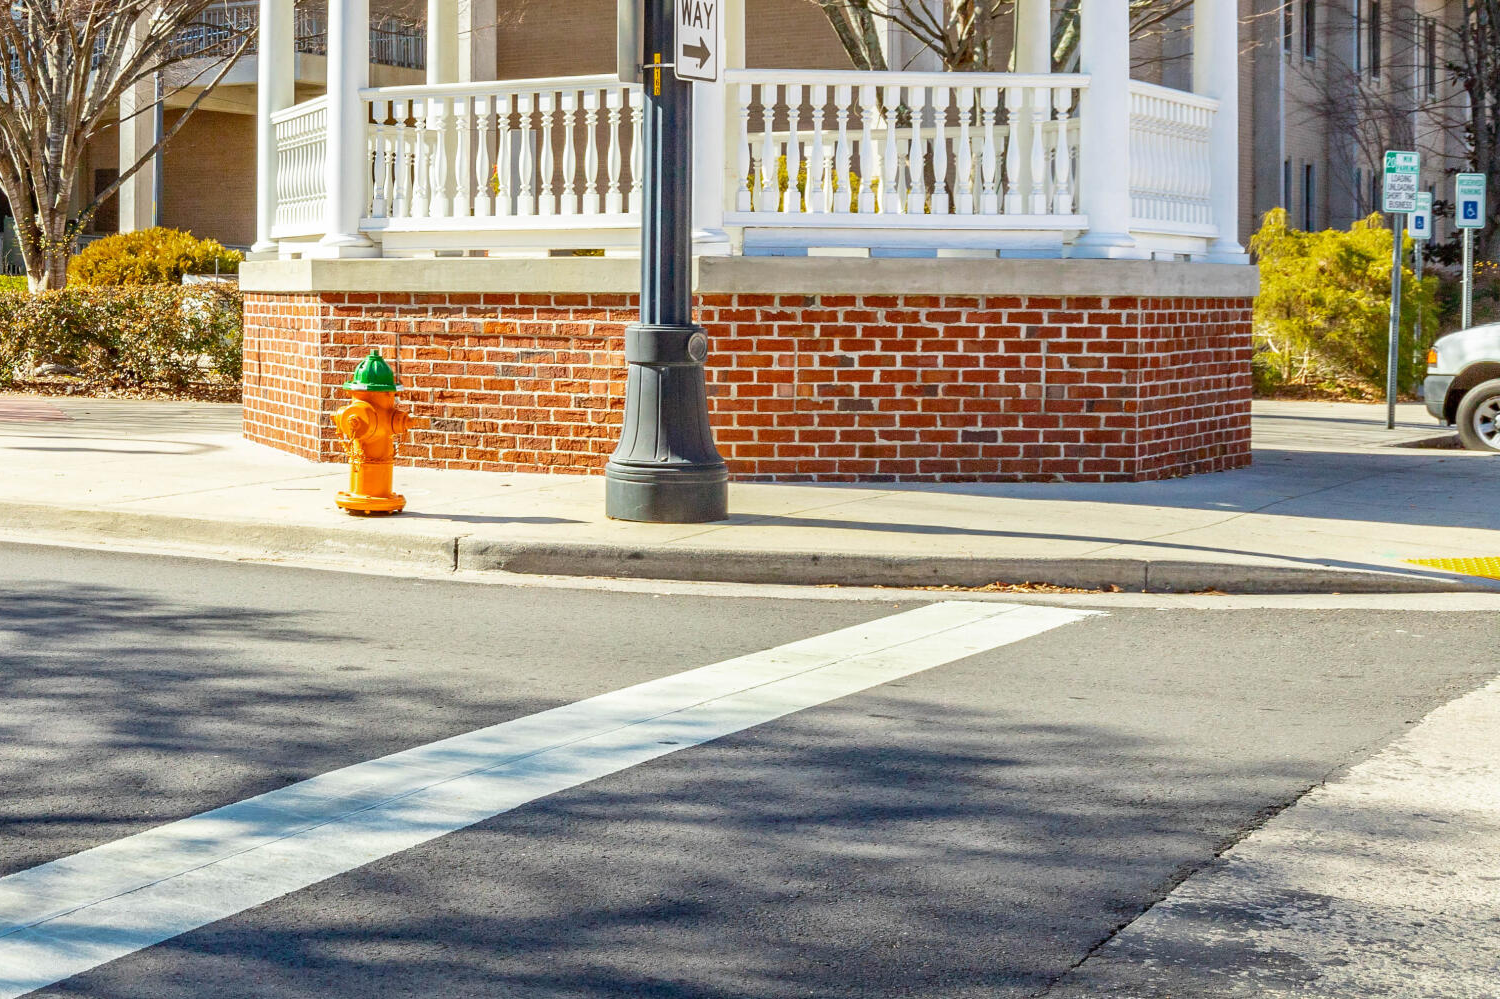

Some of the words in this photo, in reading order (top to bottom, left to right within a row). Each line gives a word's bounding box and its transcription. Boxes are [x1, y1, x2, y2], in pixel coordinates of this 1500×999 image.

[1387, 157, 1396, 168] 20
[1391, 175, 1412, 183] LOADING
[1388, 183, 1415, 191] UNLOADING
[1386, 192, 1402, 200] SHORT
[1389, 201, 1412, 209] BUSINESS
